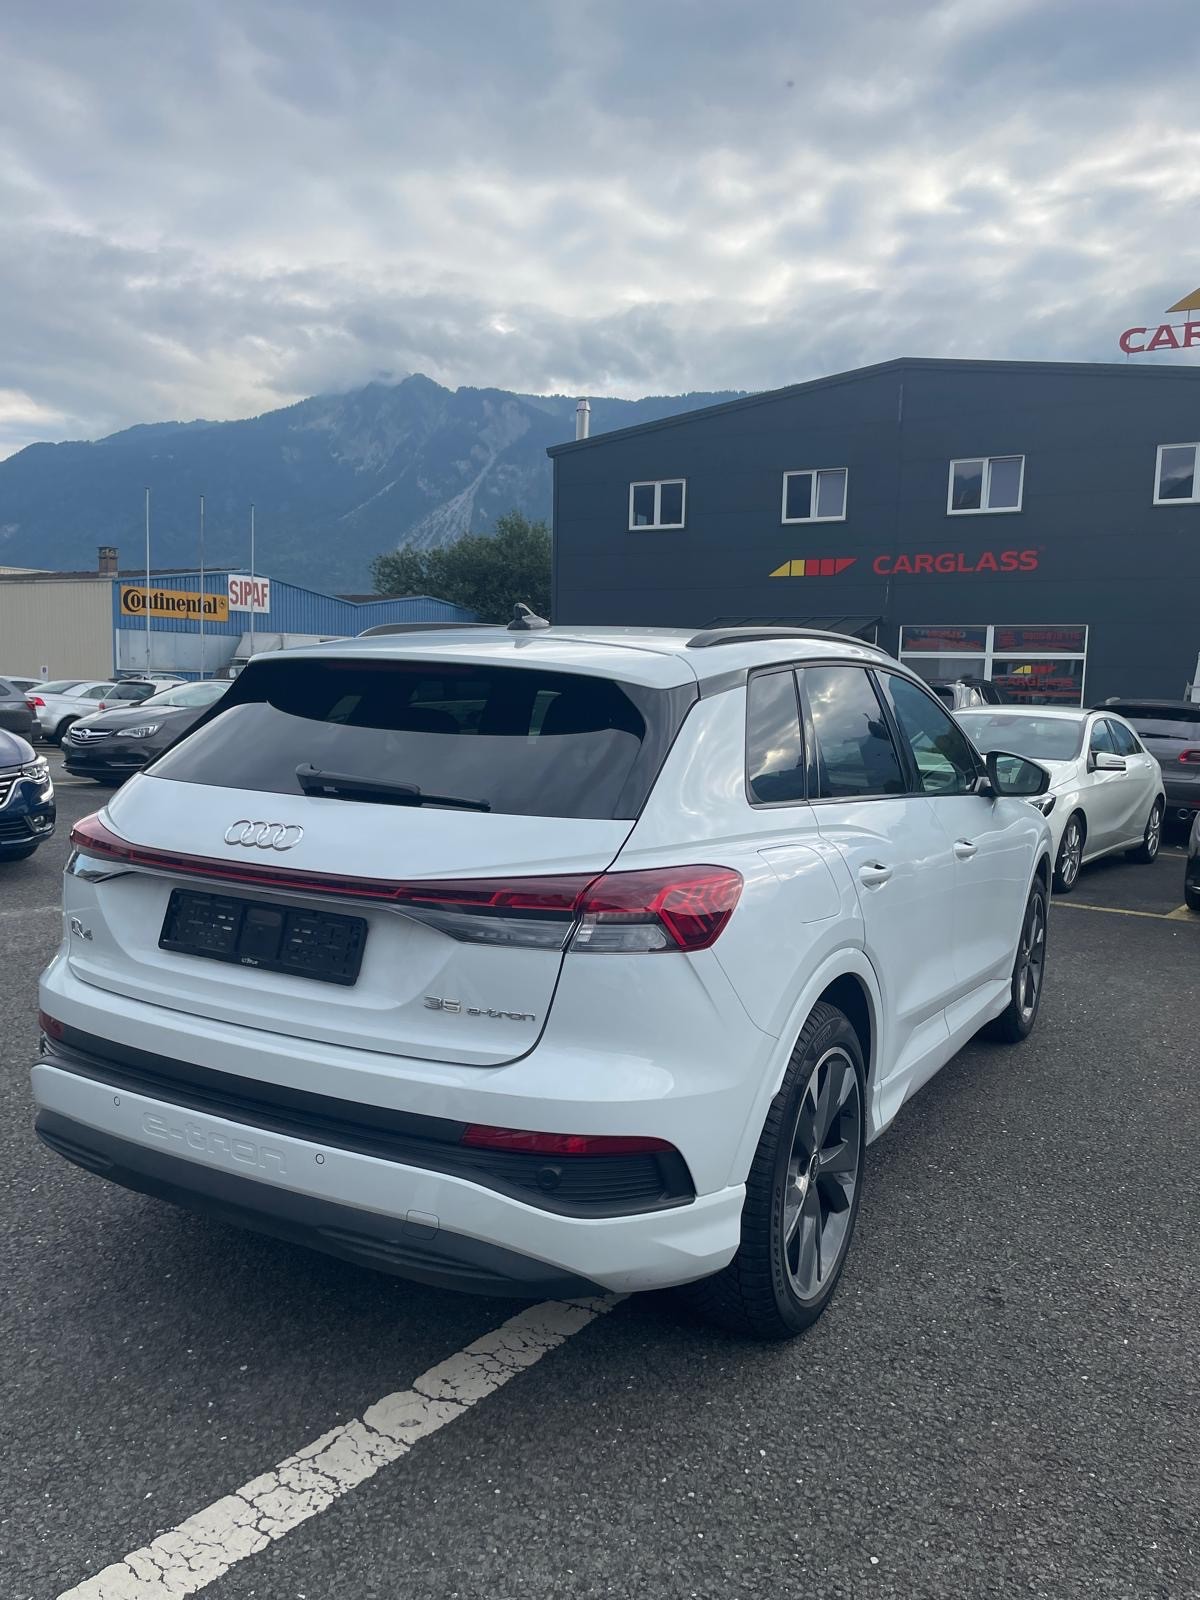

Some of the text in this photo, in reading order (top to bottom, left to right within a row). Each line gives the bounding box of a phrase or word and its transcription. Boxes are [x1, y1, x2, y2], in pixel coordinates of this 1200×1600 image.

[873, 550, 1039, 575] CARGLASS
[123, 588, 218, 615] Continental
[229, 580, 269, 607] SIPAF
[71, 916, 93, 941] Q4
[423, 995, 536, 1022] 35 e-tron
[142, 1111, 288, 1175] e-tron
